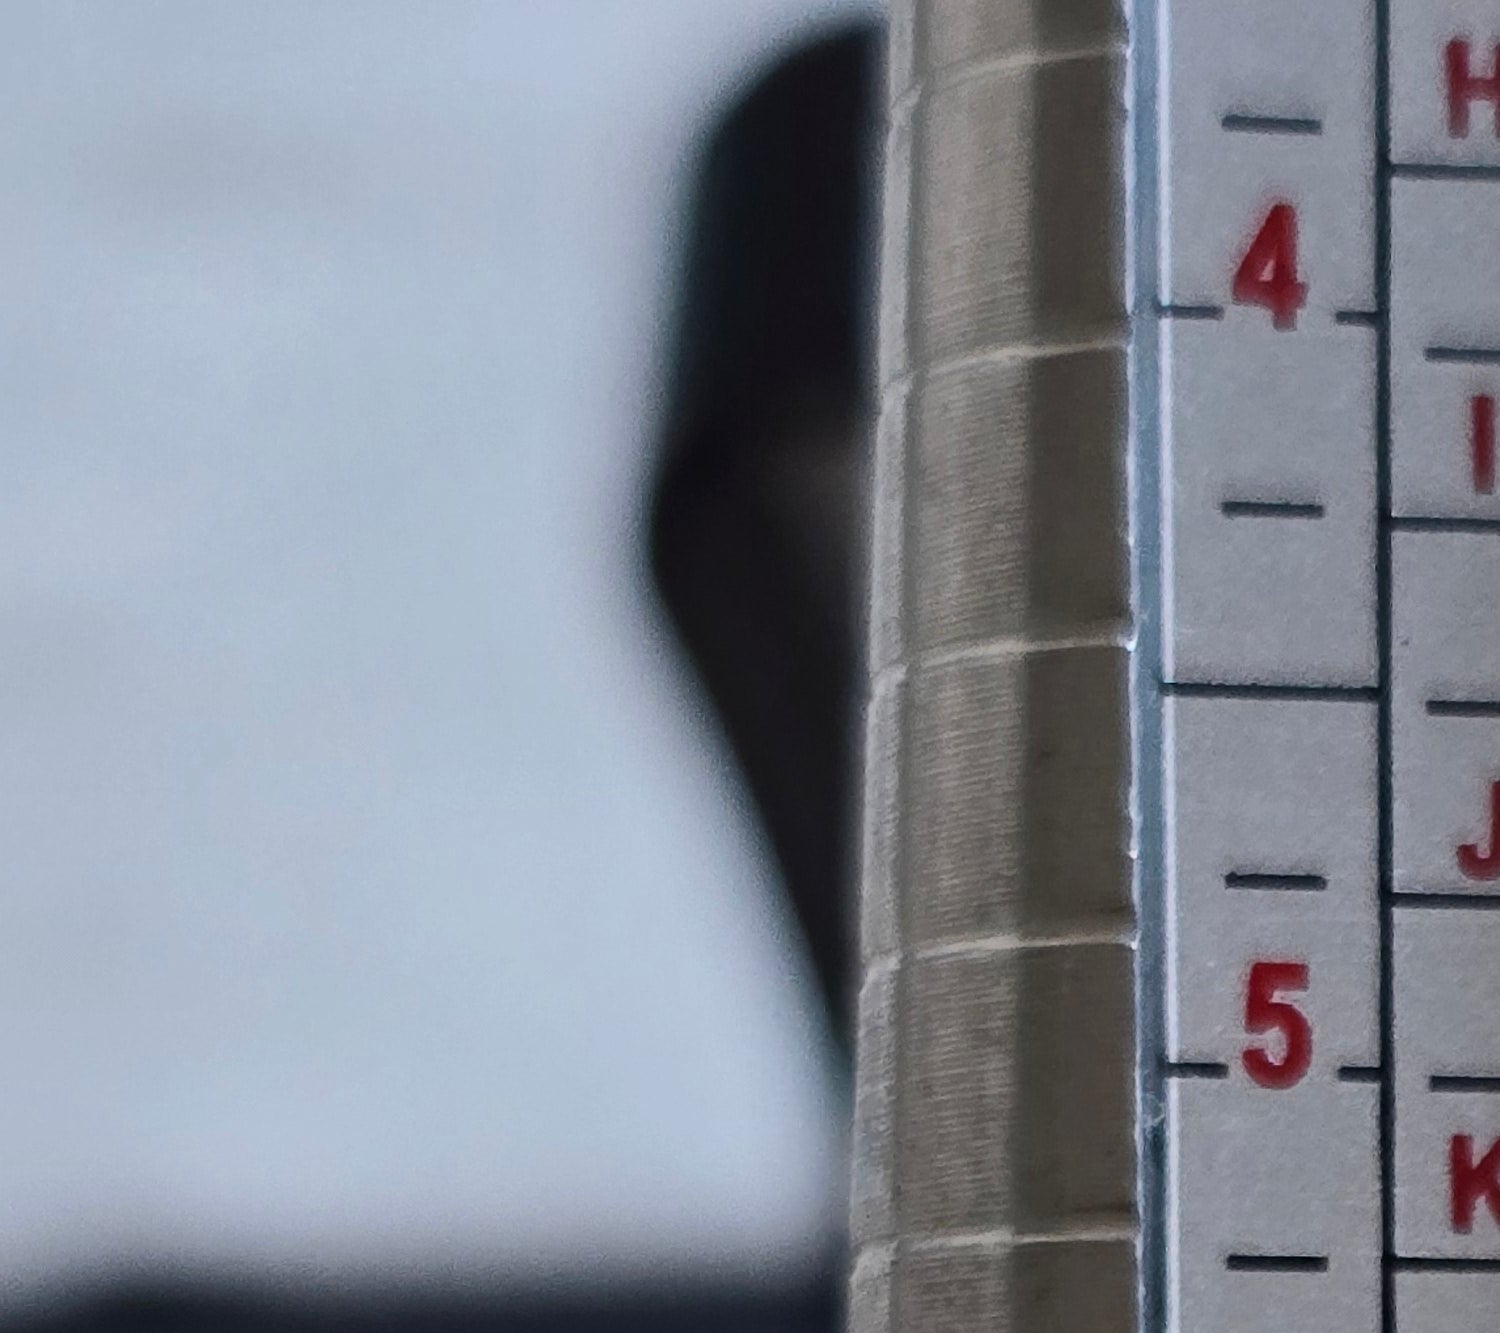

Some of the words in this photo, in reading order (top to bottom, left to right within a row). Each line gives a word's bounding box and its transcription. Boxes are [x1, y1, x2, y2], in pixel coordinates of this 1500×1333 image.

[1234, 204, 1305, 321] 4
[1473, 397, 1494, 488] I
[1242, 960, 1312, 1088] 5
